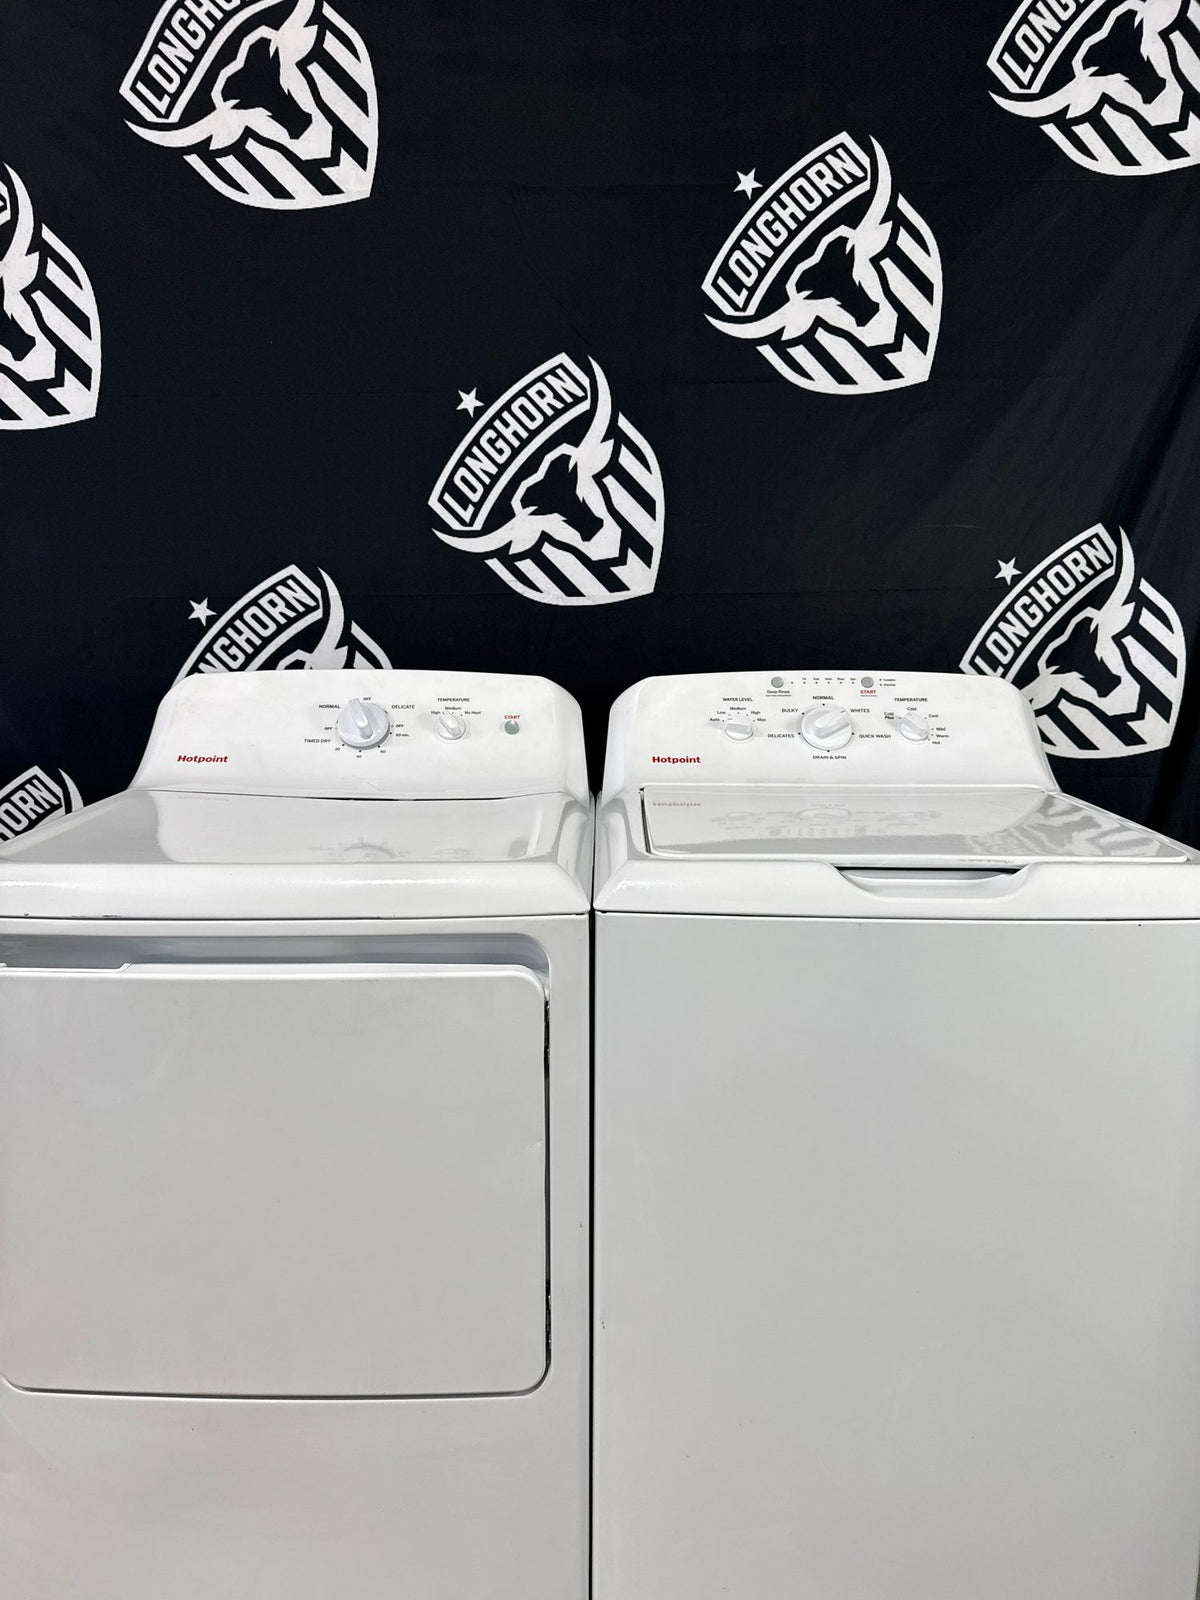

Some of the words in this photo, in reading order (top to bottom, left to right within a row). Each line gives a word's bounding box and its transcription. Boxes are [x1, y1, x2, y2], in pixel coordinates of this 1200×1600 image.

[716, 147, 866, 309] LONGHORN
[442, 367, 586, 524] LONGHORN
[974, 537, 1112, 677] LONGHORN
[177, 754, 228, 764] Hotpoint
[652, 755, 701, 764] Hotpoint
